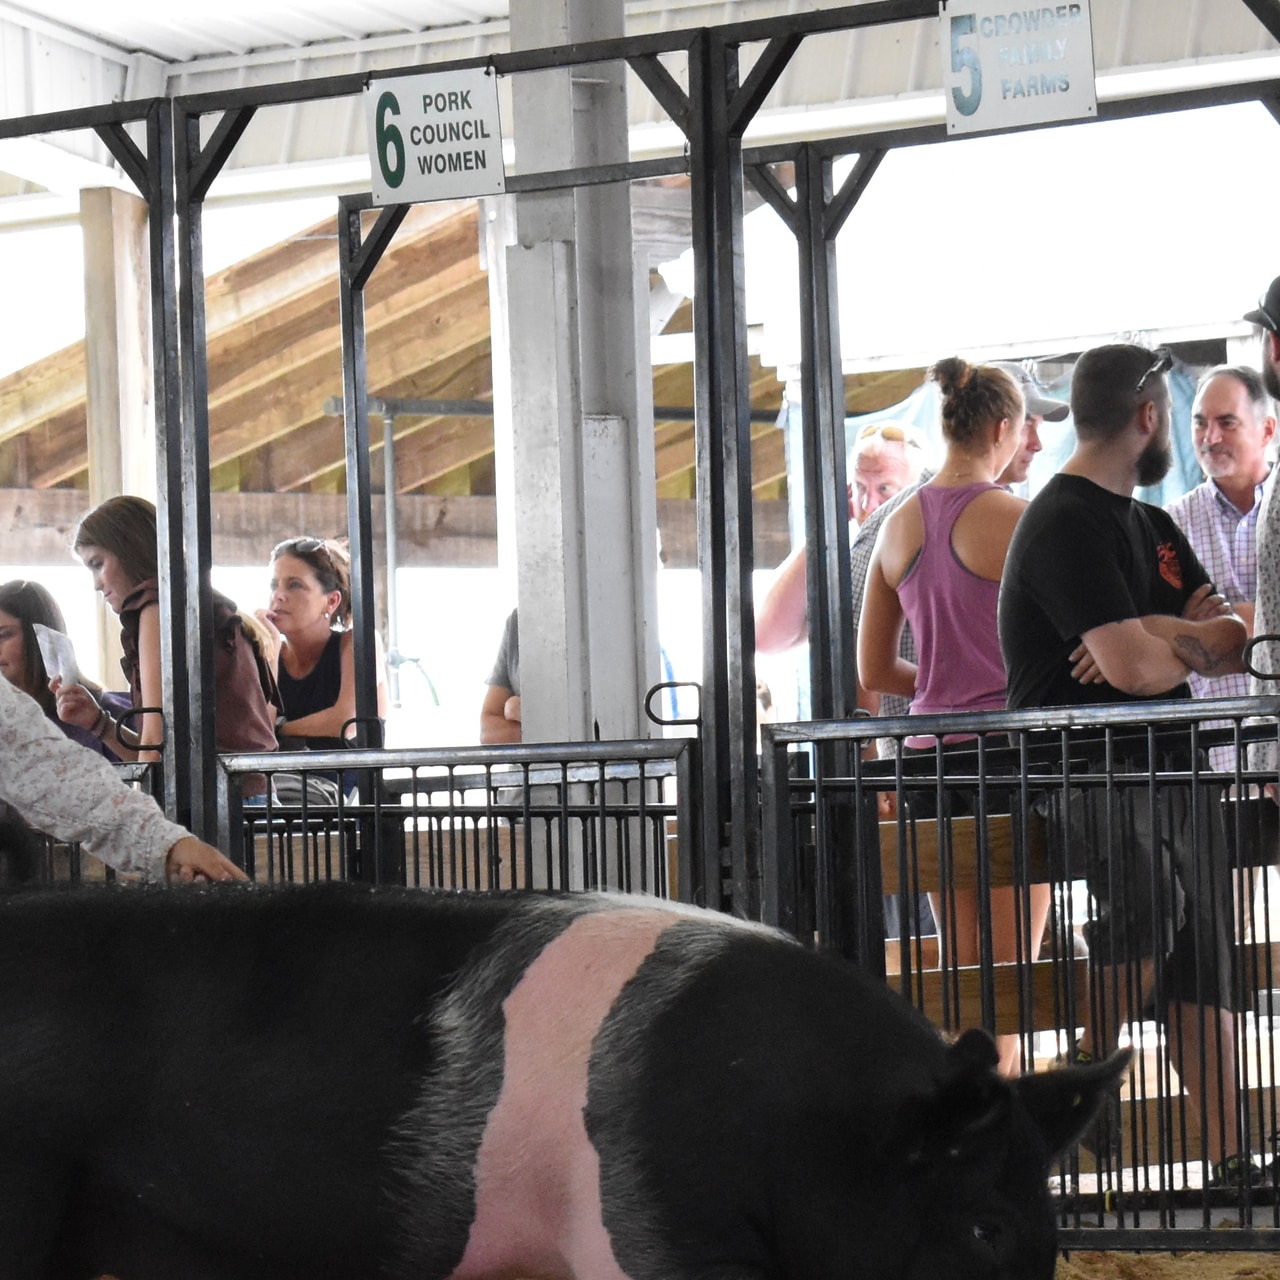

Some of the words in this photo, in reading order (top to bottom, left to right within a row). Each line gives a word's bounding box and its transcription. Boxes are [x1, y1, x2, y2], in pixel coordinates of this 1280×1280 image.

[980, 3, 1082, 38] CROWDER
[951, 13, 983, 117] 5
[1001, 72, 1070, 100] FARMS
[422, 90, 472, 114] PORK
[375, 90, 406, 189] 6
[410, 119, 491, 146] COUNCIL
[417, 150, 487, 175] WOMEN
